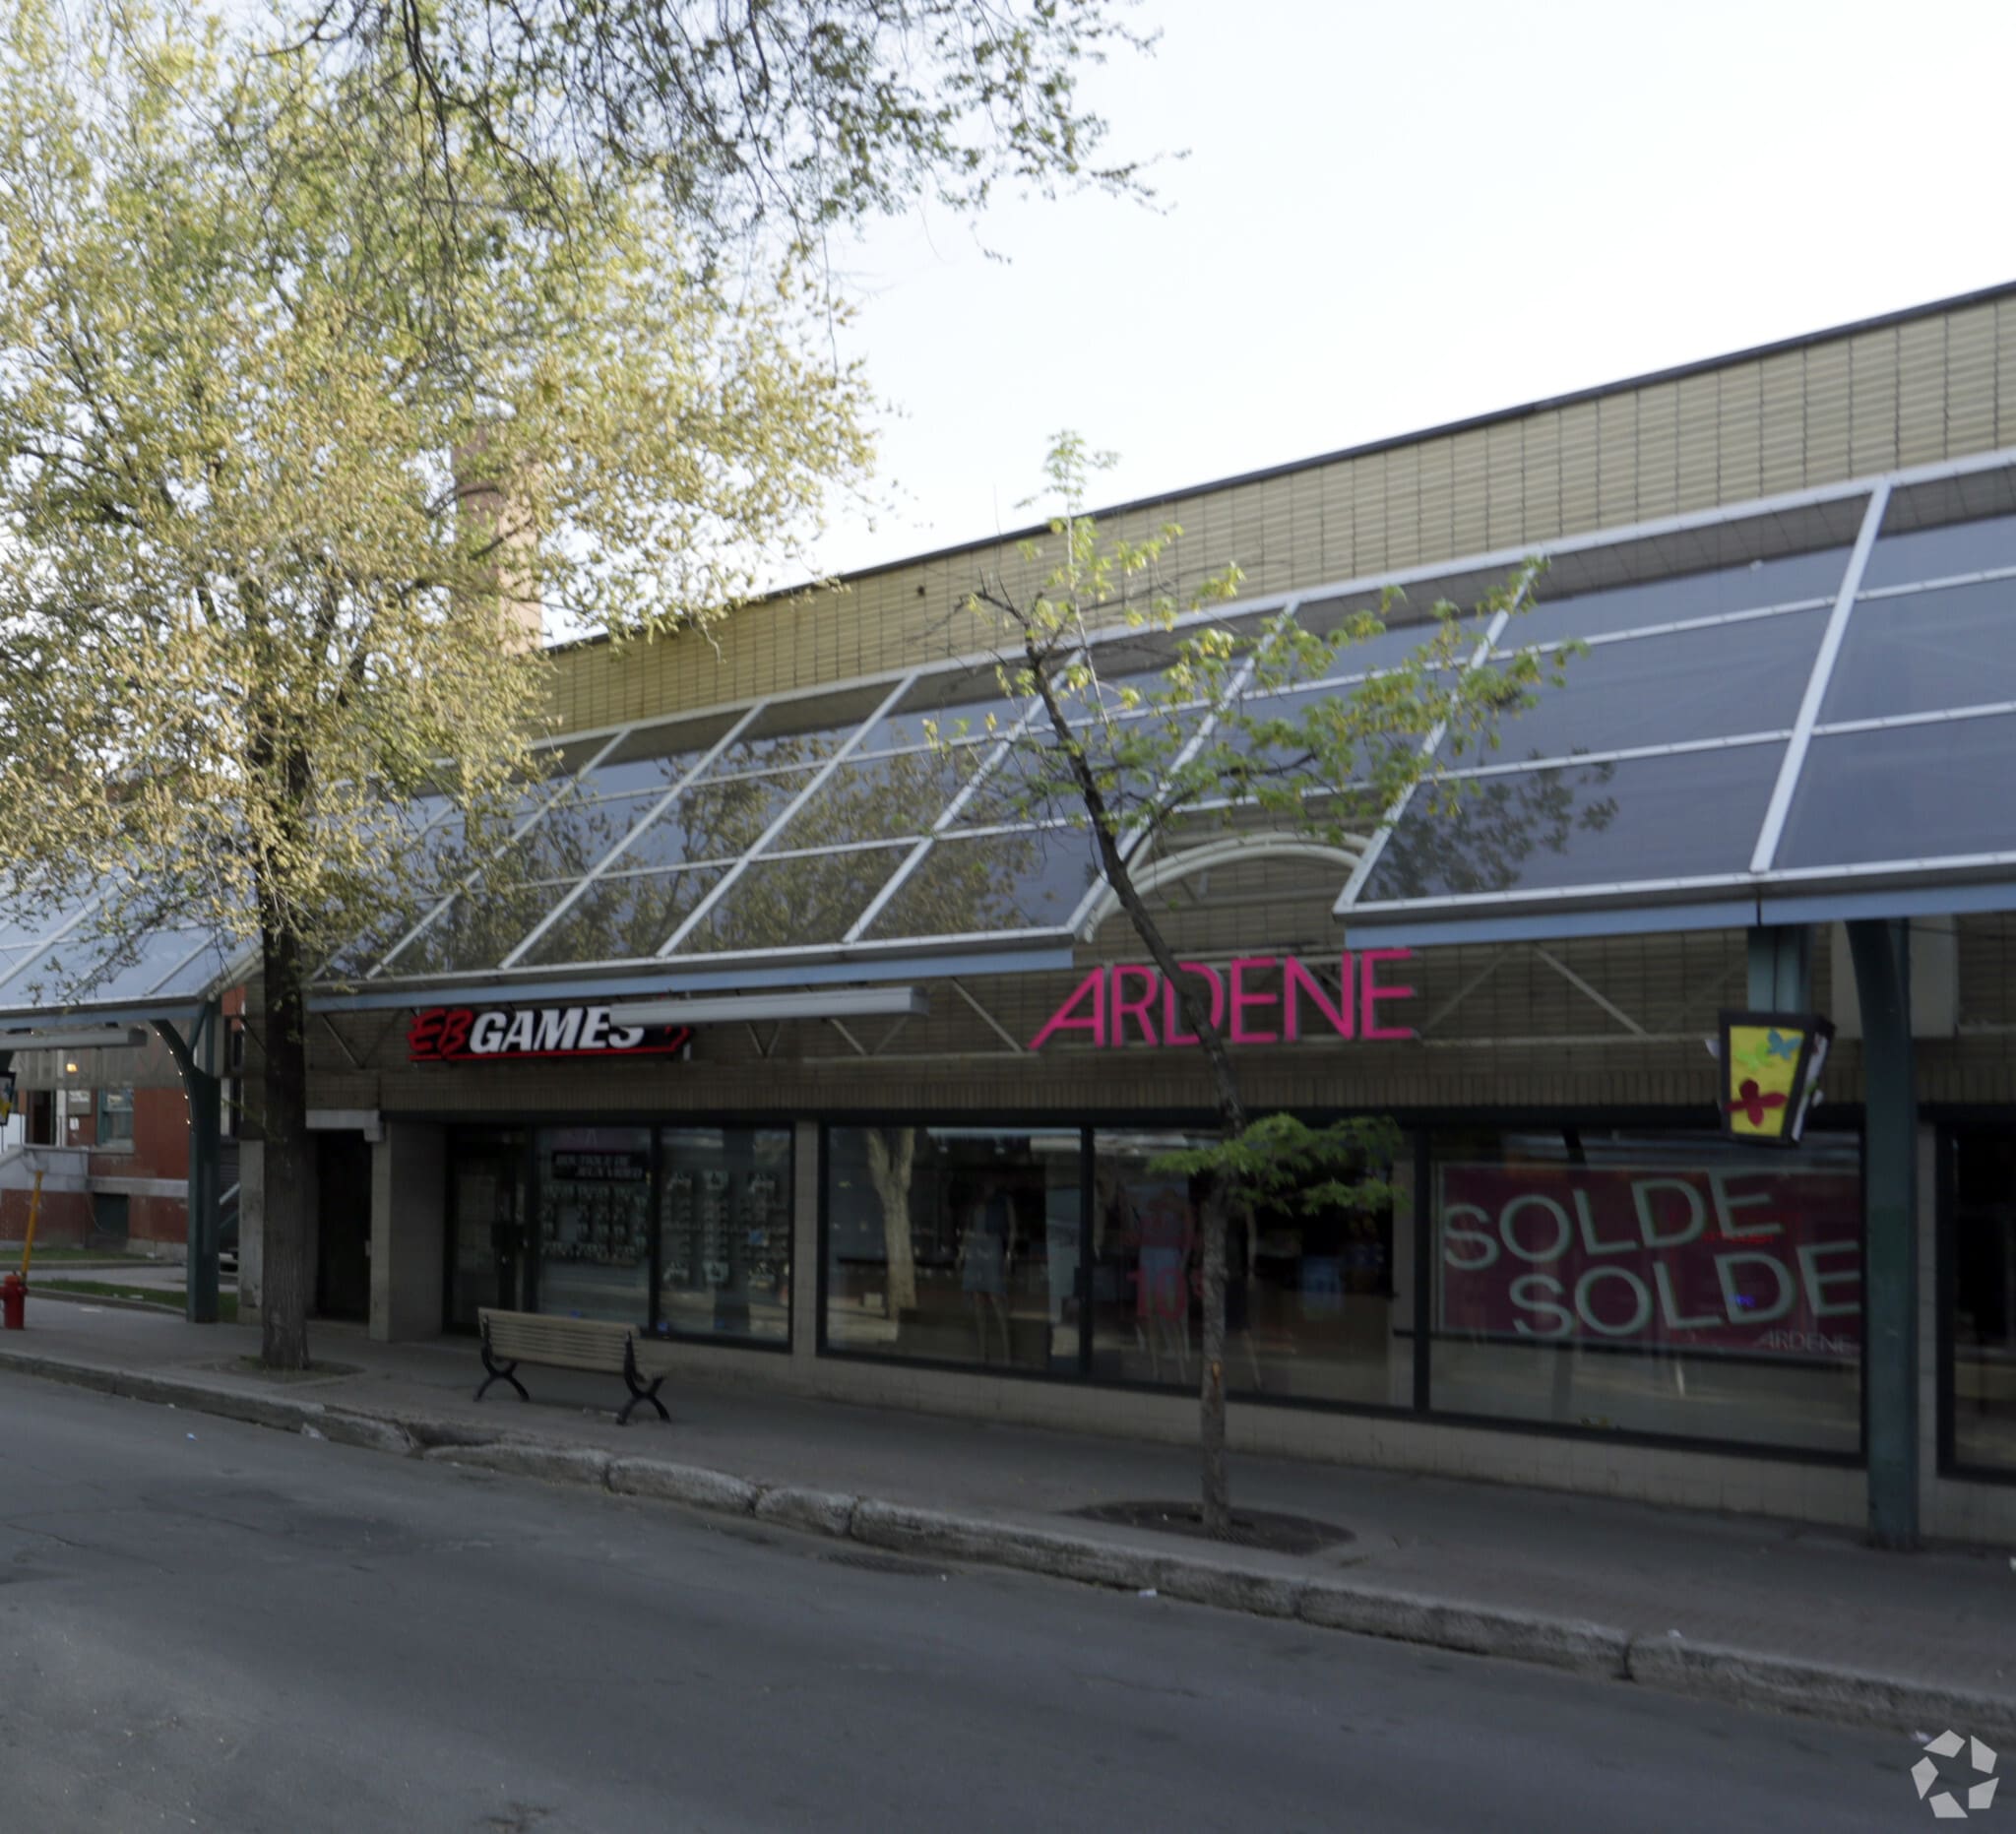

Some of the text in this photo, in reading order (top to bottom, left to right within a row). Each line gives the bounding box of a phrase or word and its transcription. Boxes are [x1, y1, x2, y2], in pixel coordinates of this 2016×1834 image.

[408, 1007, 474, 1056] EB
[1029, 948, 1415, 1050] ARDENE
[1443, 1169, 1784, 1271] SOLDE
[1508, 1239, 1860, 1338] SOLDE
